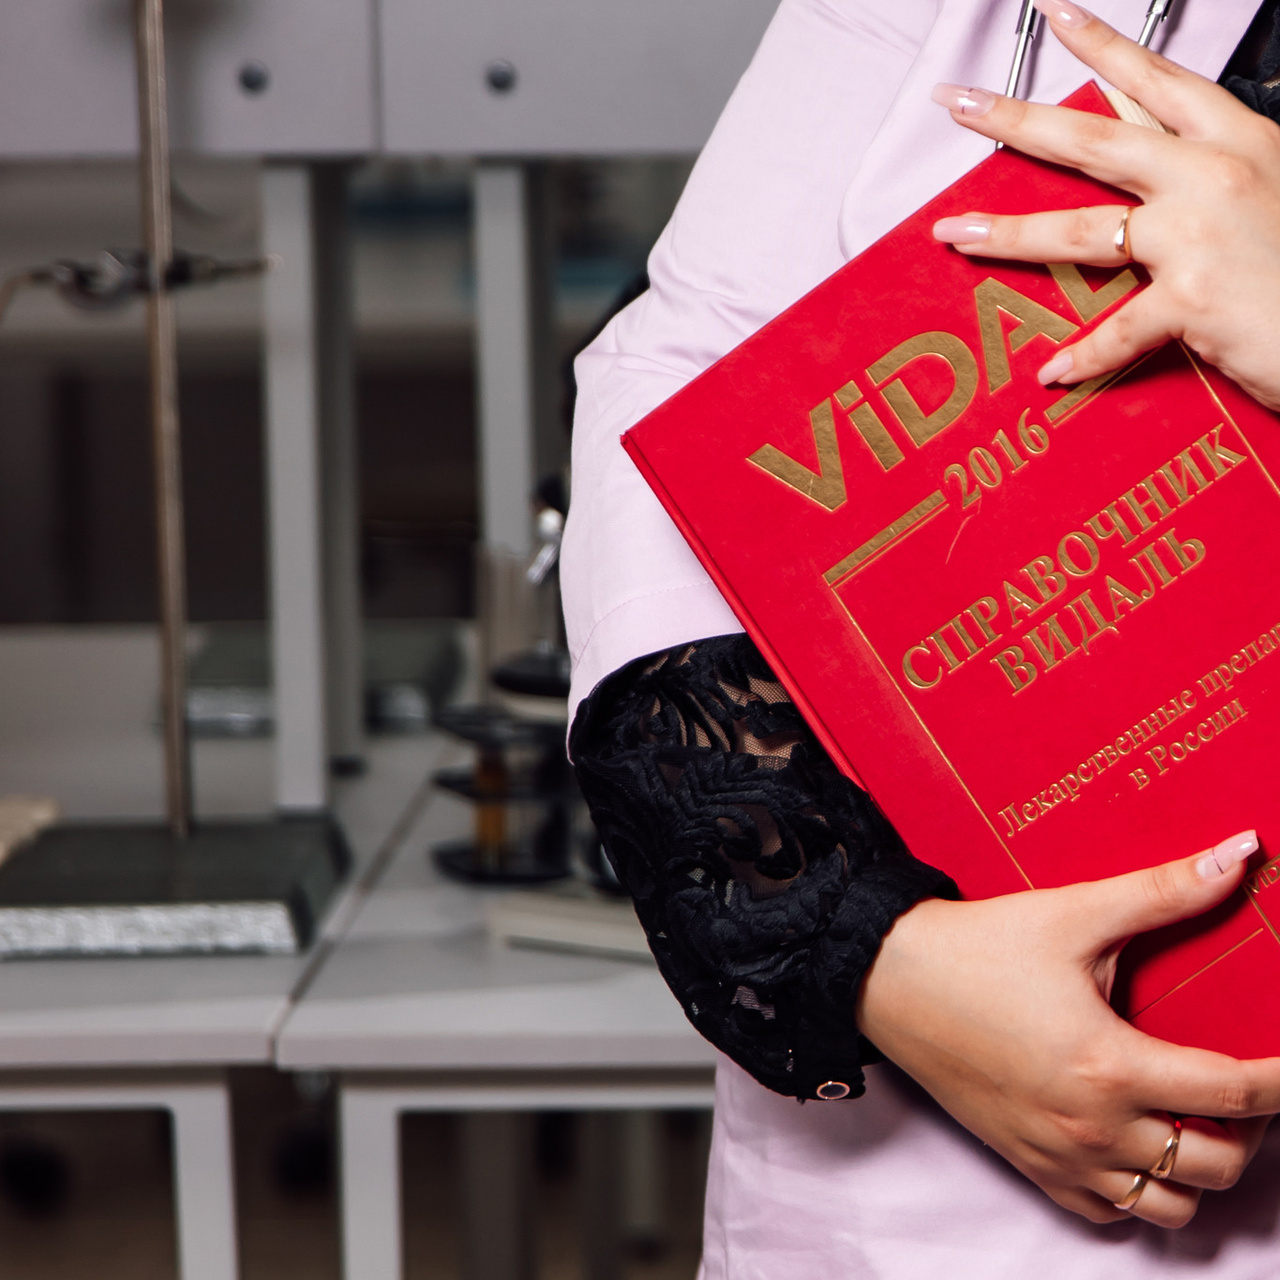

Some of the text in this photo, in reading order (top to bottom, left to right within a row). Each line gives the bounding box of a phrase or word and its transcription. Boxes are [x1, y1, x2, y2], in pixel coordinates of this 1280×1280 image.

[746, 263, 1140, 512] ViDAL
[944, 407, 1050, 510] 2016
[902, 422, 1248, 690] СПРАВОЧНИК
[990, 528, 1207, 697] ВИДАЛЬ
[998, 689, 1198, 838] Лекарственные
[1128, 697, 1250, 790] в России
